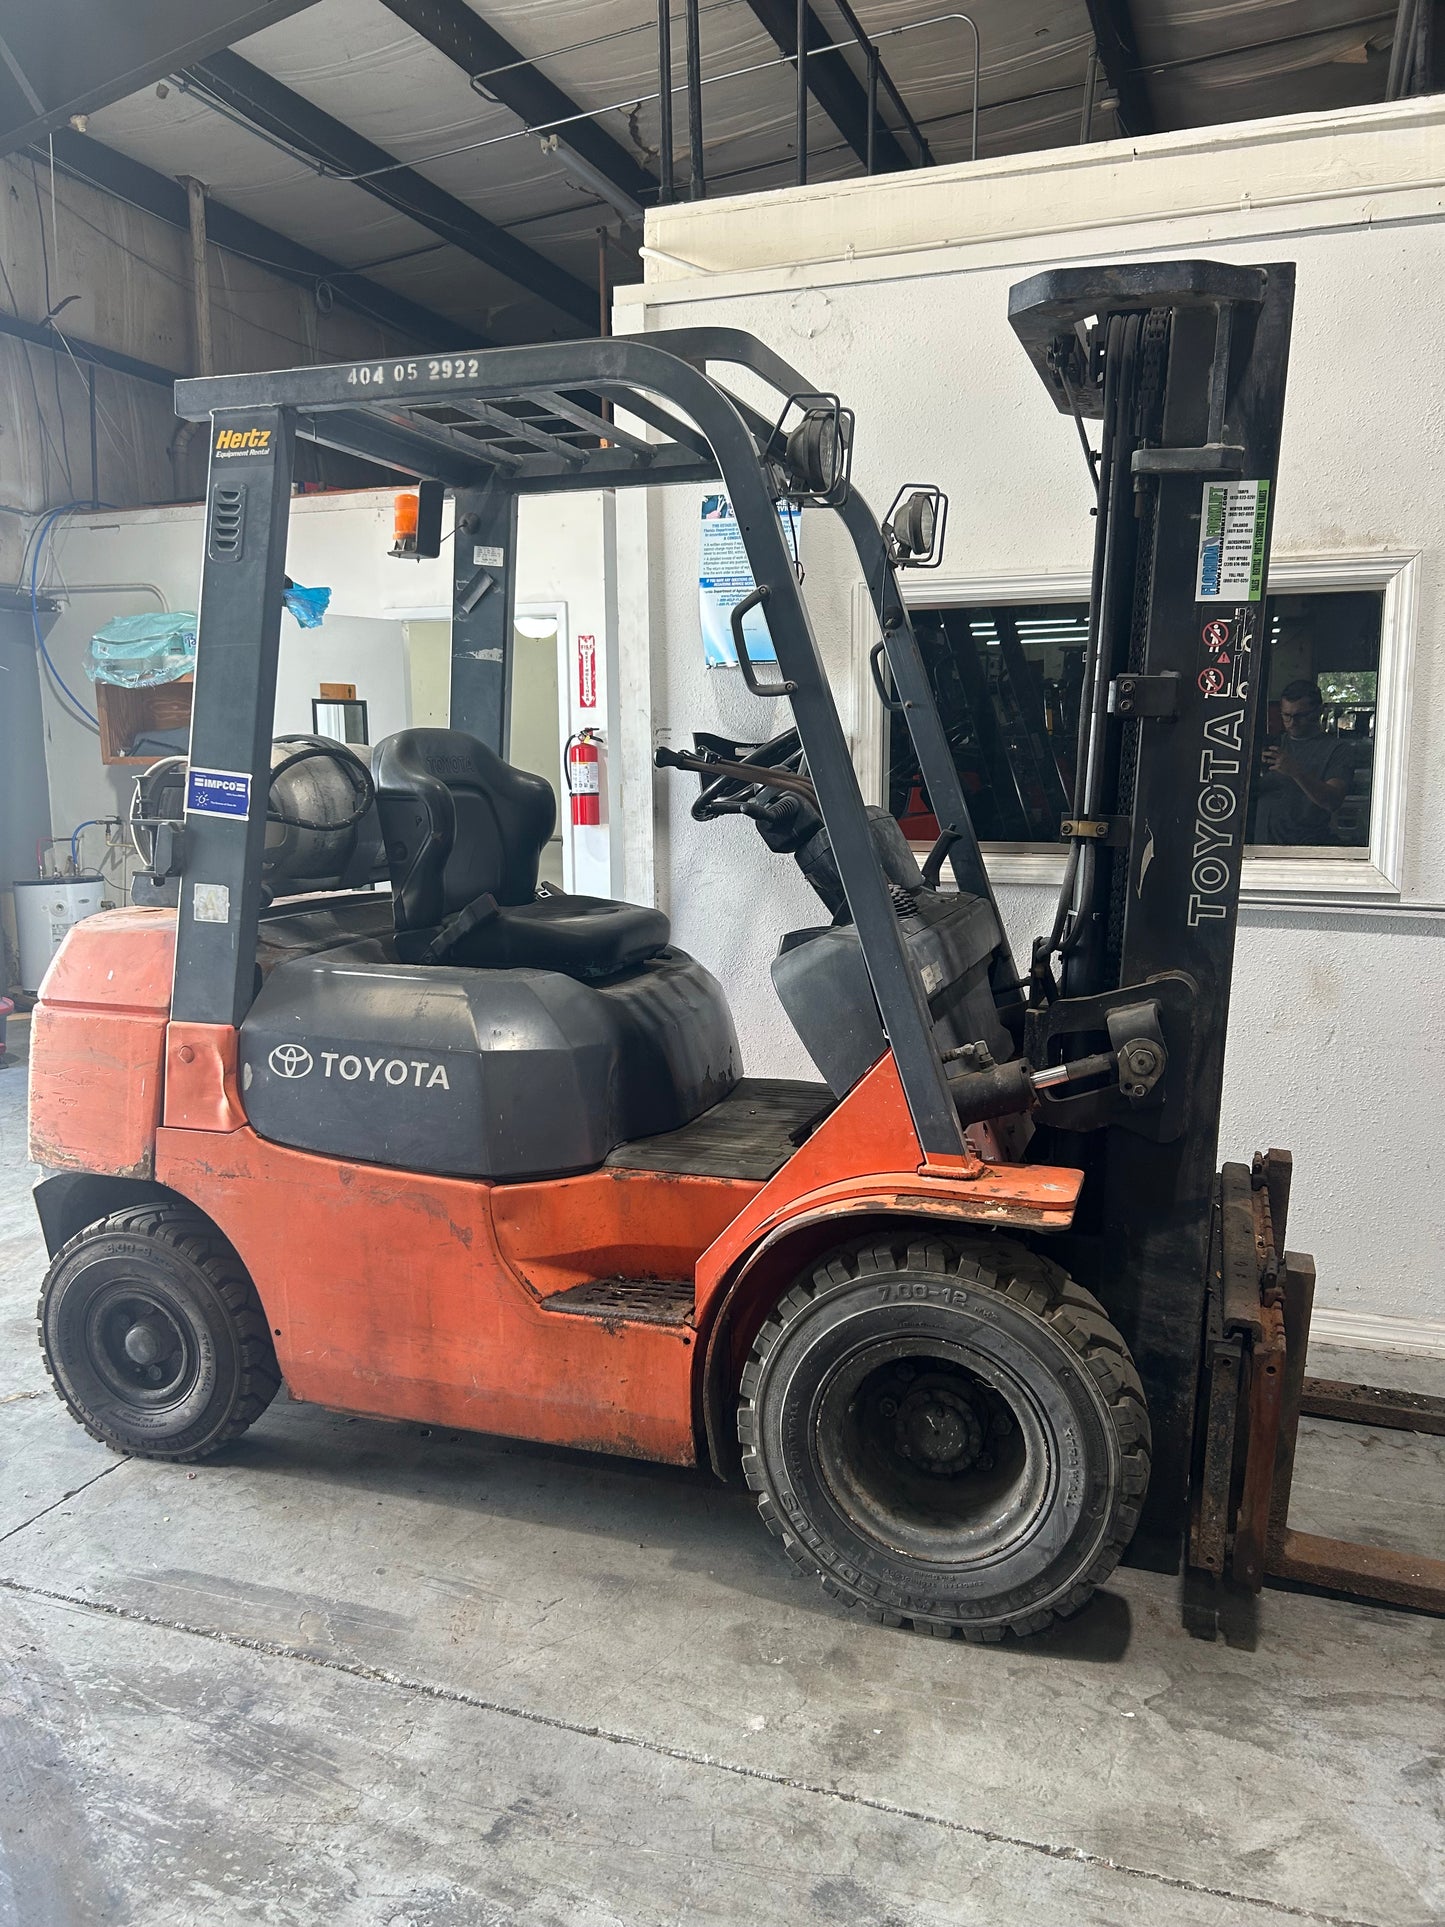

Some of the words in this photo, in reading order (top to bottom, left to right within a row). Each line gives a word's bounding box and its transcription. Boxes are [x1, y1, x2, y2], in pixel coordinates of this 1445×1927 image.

[347, 365, 385, 385] 404
[393, 363, 419, 382] 05
[428, 358, 480, 380] 2922
[215, 428, 271, 449] Hertz
[215, 450, 249, 458] Equipment
[249, 448, 271, 456] Rental
[1206, 486, 1224, 537] FORKLIFT
[1255, 521, 1264, 538] SERVICE
[1215, 488, 1228, 595] WWW.FLORIDAFORKLIFT.COM
[1201, 545, 1220, 596] FLORIDA
[1252, 558, 1261, 576] RENTALS
[1251, 579, 1260, 591] SALES
[426, 754, 473, 774] TOYOTA
[204, 778, 237, 791] IMPCO
[1188, 708, 1245, 928] TOYOTA
[320, 1052, 450, 1090] TOYOTA
